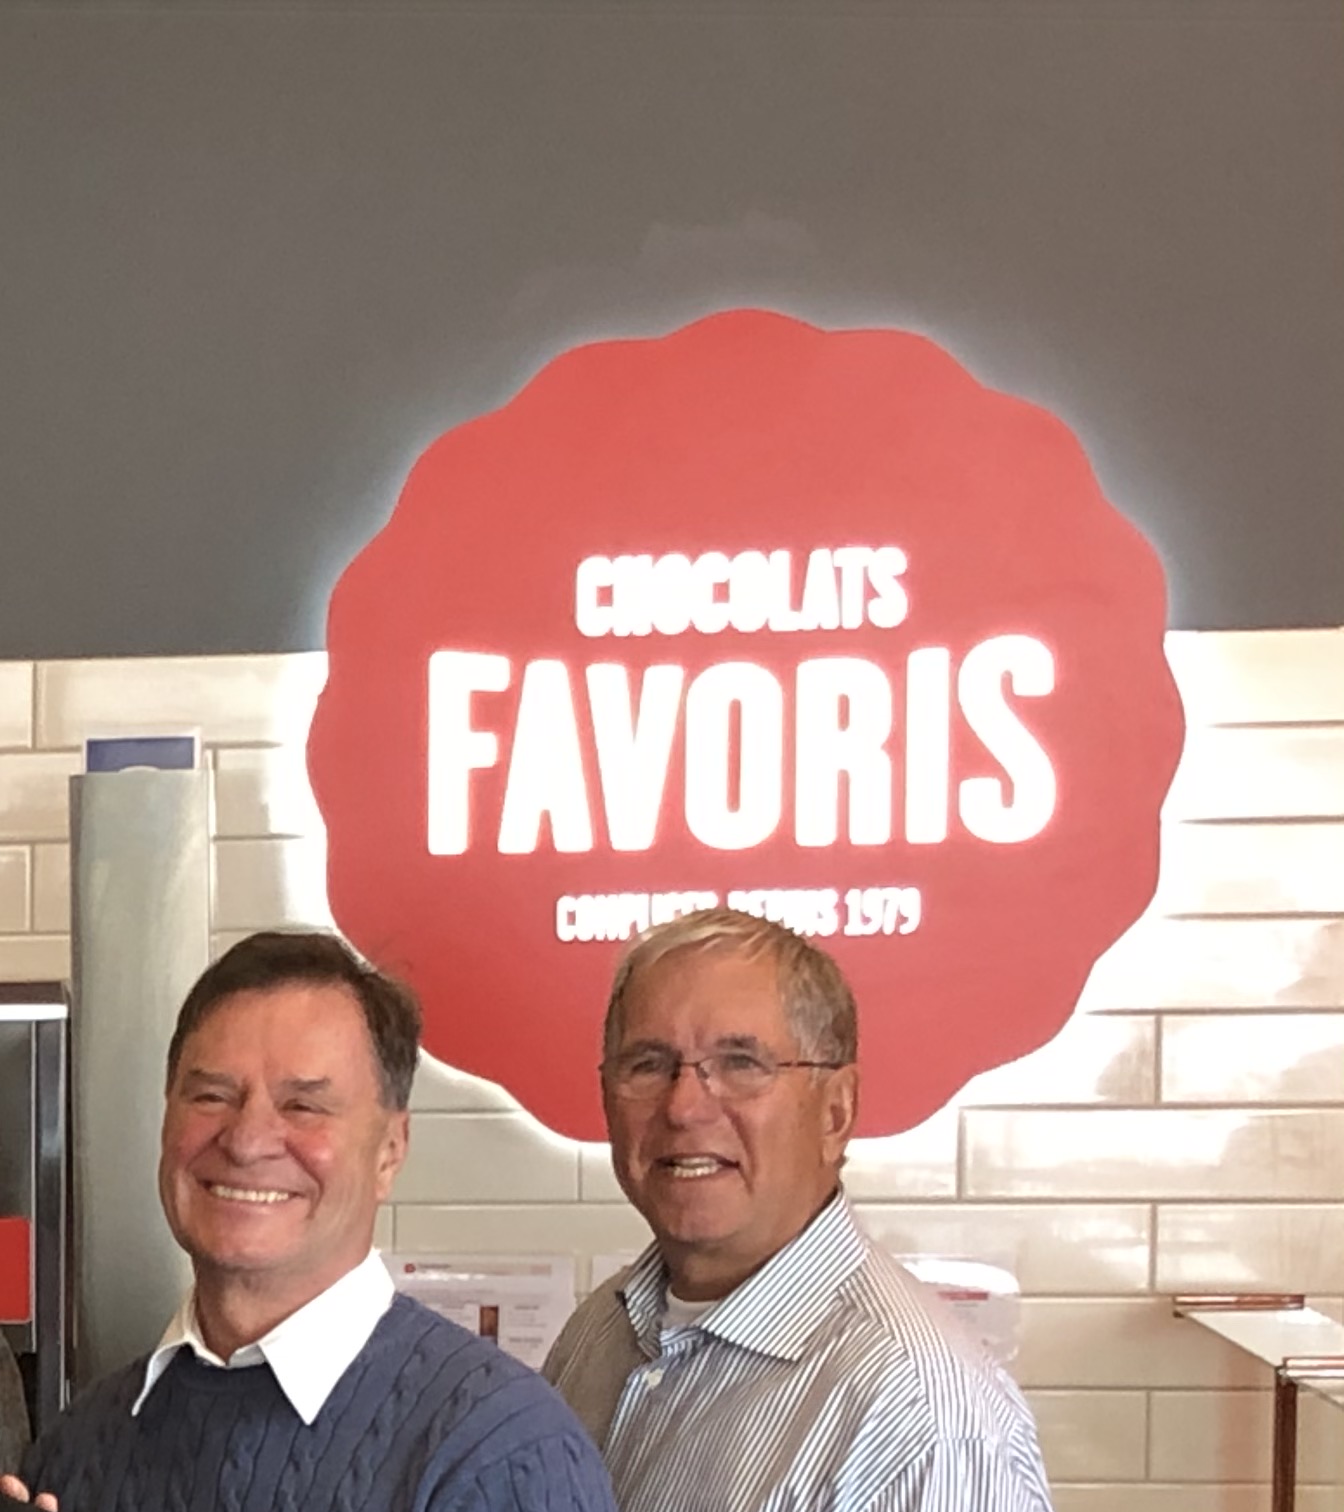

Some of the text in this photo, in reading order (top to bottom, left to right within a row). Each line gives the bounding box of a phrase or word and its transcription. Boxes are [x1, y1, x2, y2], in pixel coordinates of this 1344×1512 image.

[576, 547, 908, 636] CHOCOLATS
[427, 634, 1057, 855] FAVORIS
[843, 887, 922, 937] 1979
